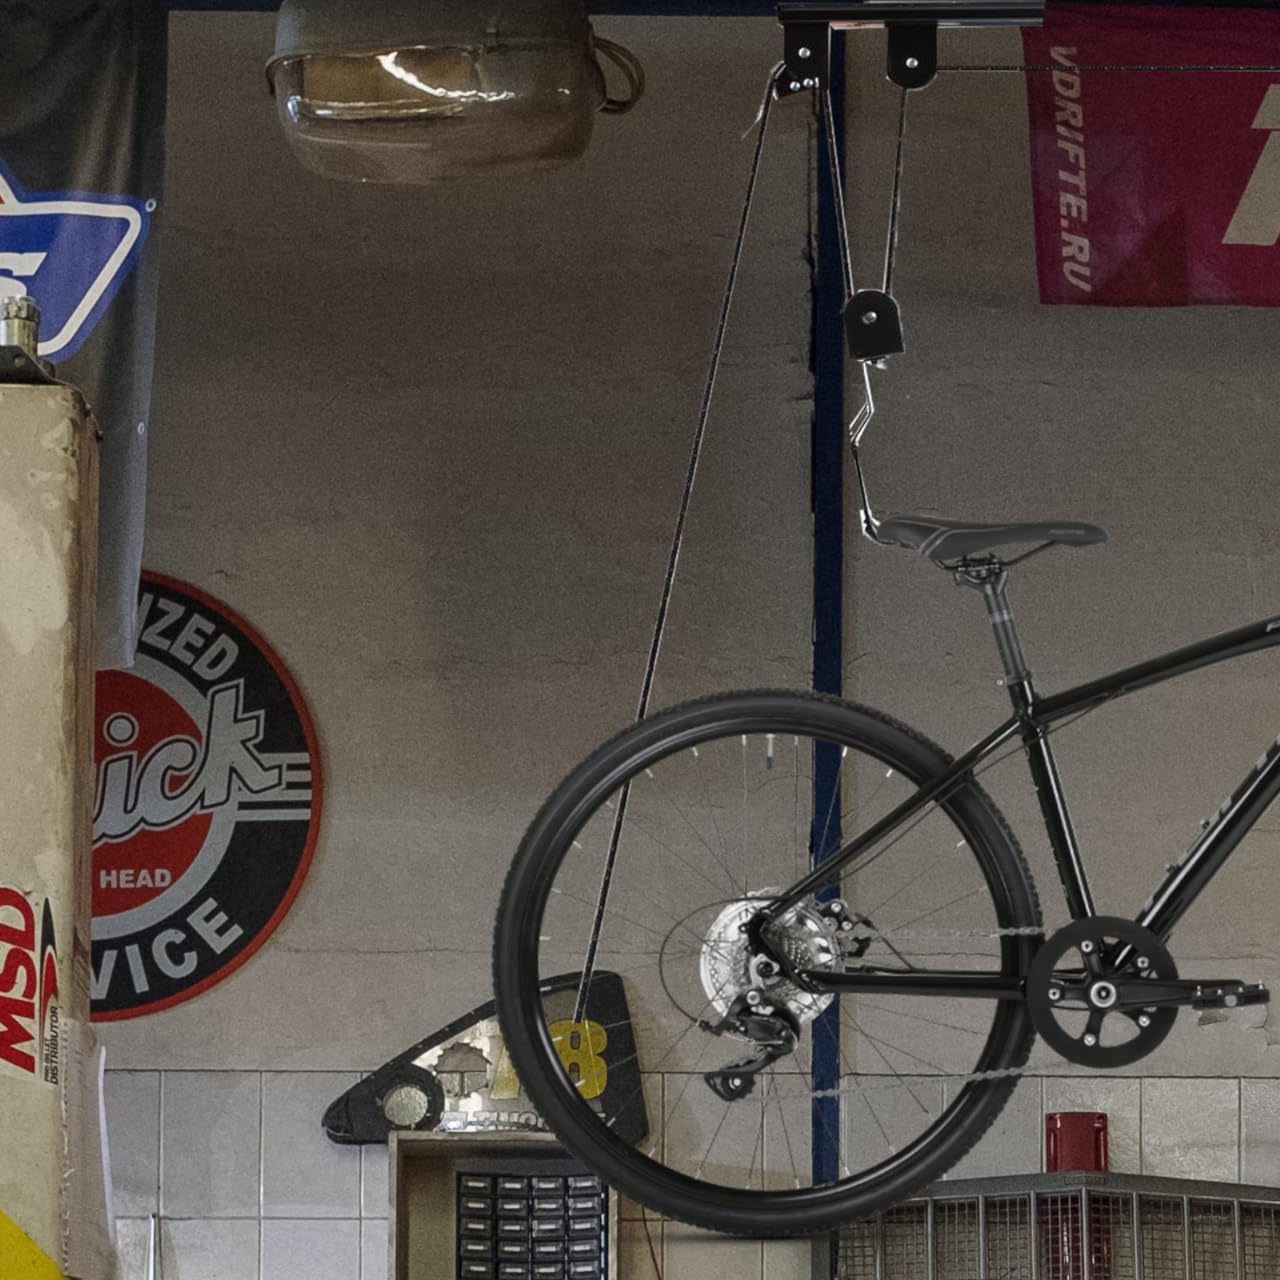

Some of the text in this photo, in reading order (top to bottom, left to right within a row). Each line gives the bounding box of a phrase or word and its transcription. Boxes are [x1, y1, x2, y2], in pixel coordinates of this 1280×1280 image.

[1049, 45, 1092, 293] VDRIFTE.RU
[93, 679, 282, 842] ick
[99, 868, 172, 889] HEAD
[0, 887, 37, 1075] MSD
[50, 1006, 59, 1086] DISTRIBUTOR
